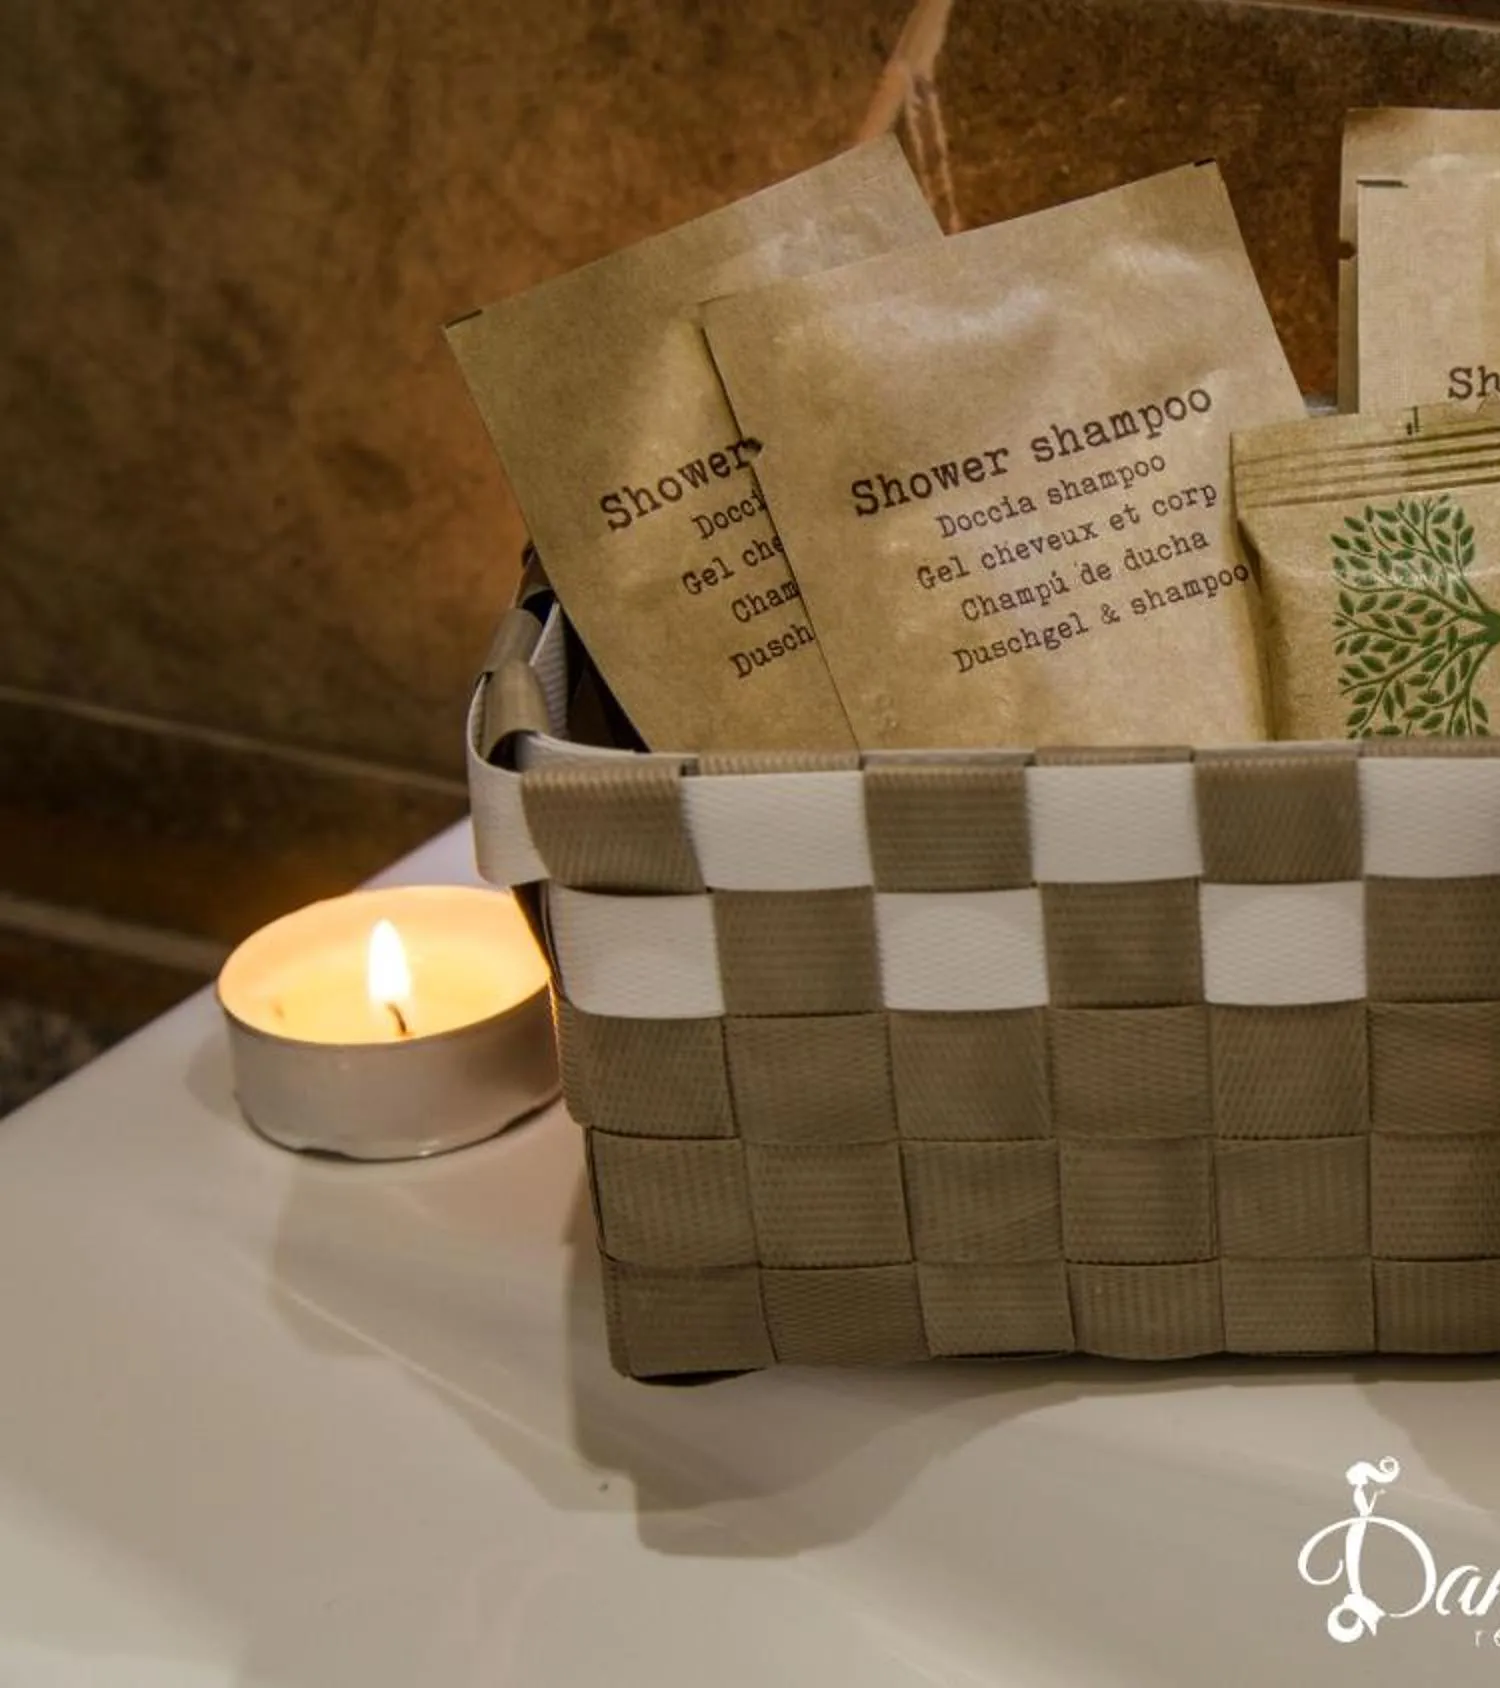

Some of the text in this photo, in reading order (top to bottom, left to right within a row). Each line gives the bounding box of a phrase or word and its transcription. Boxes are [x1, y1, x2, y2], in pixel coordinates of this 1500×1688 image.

[600, 438, 757, 531] Shower
[851, 389, 1212, 517] Shower shampoo
[935, 453, 1166, 538] Doccia shampoo
[682, 556, 735, 595] Gel
[917, 484, 1217, 590] Gel cheveux et corp
[961, 531, 1210, 621] Champú de ducha
[729, 624, 814, 679] Dusch
[952, 564, 1249, 673] Duschgel & shampoo
